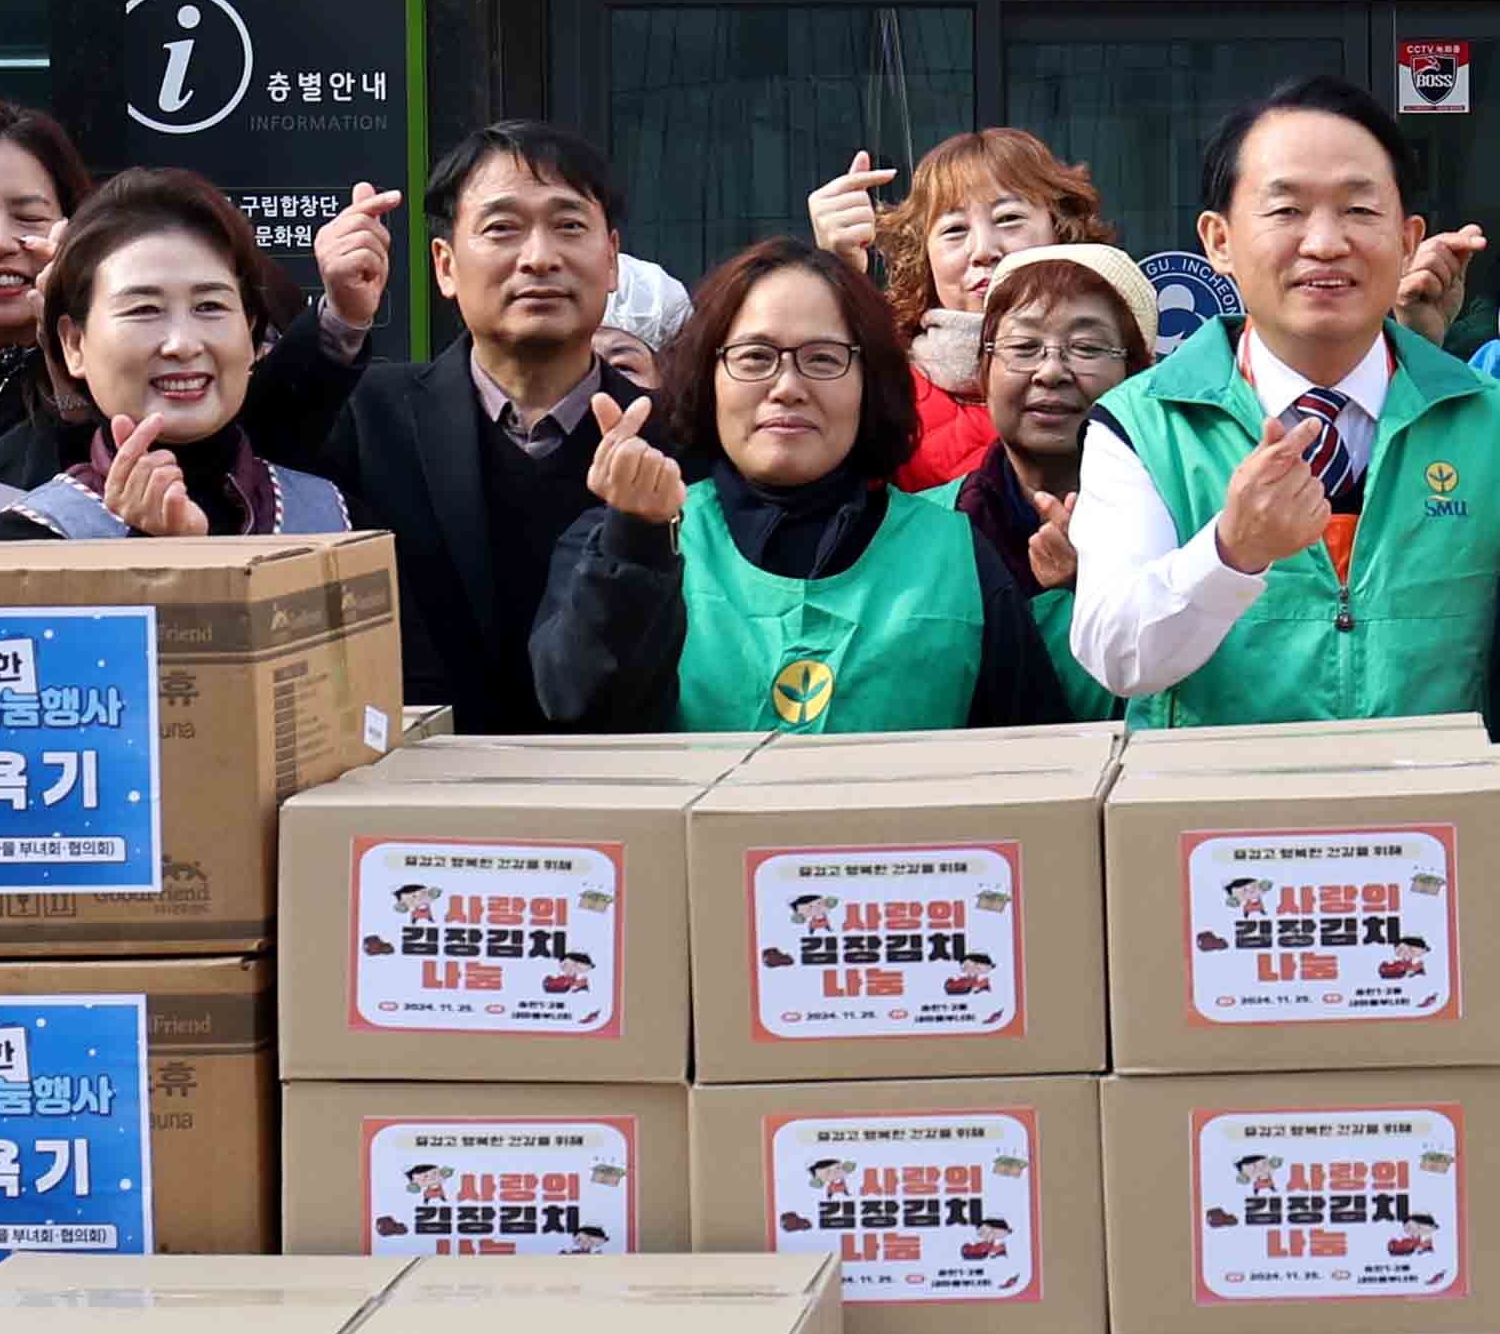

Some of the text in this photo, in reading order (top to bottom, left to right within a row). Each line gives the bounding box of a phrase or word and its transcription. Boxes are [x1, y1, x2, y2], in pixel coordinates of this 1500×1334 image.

[1406, 44, 1434, 54] CCTV
[266, 71, 387, 103] 층별안내
[1416, 74, 1453, 88] BOSS
[250, 114, 388, 132] INFORMATION
[239, 196, 341, 218] 구립합창단
[1425, 500, 1468, 516] SMU
[444, 895, 568, 926] 사랑의
[401, 926, 567, 959] 김장김치
[422, 959, 503, 990] 나눔
